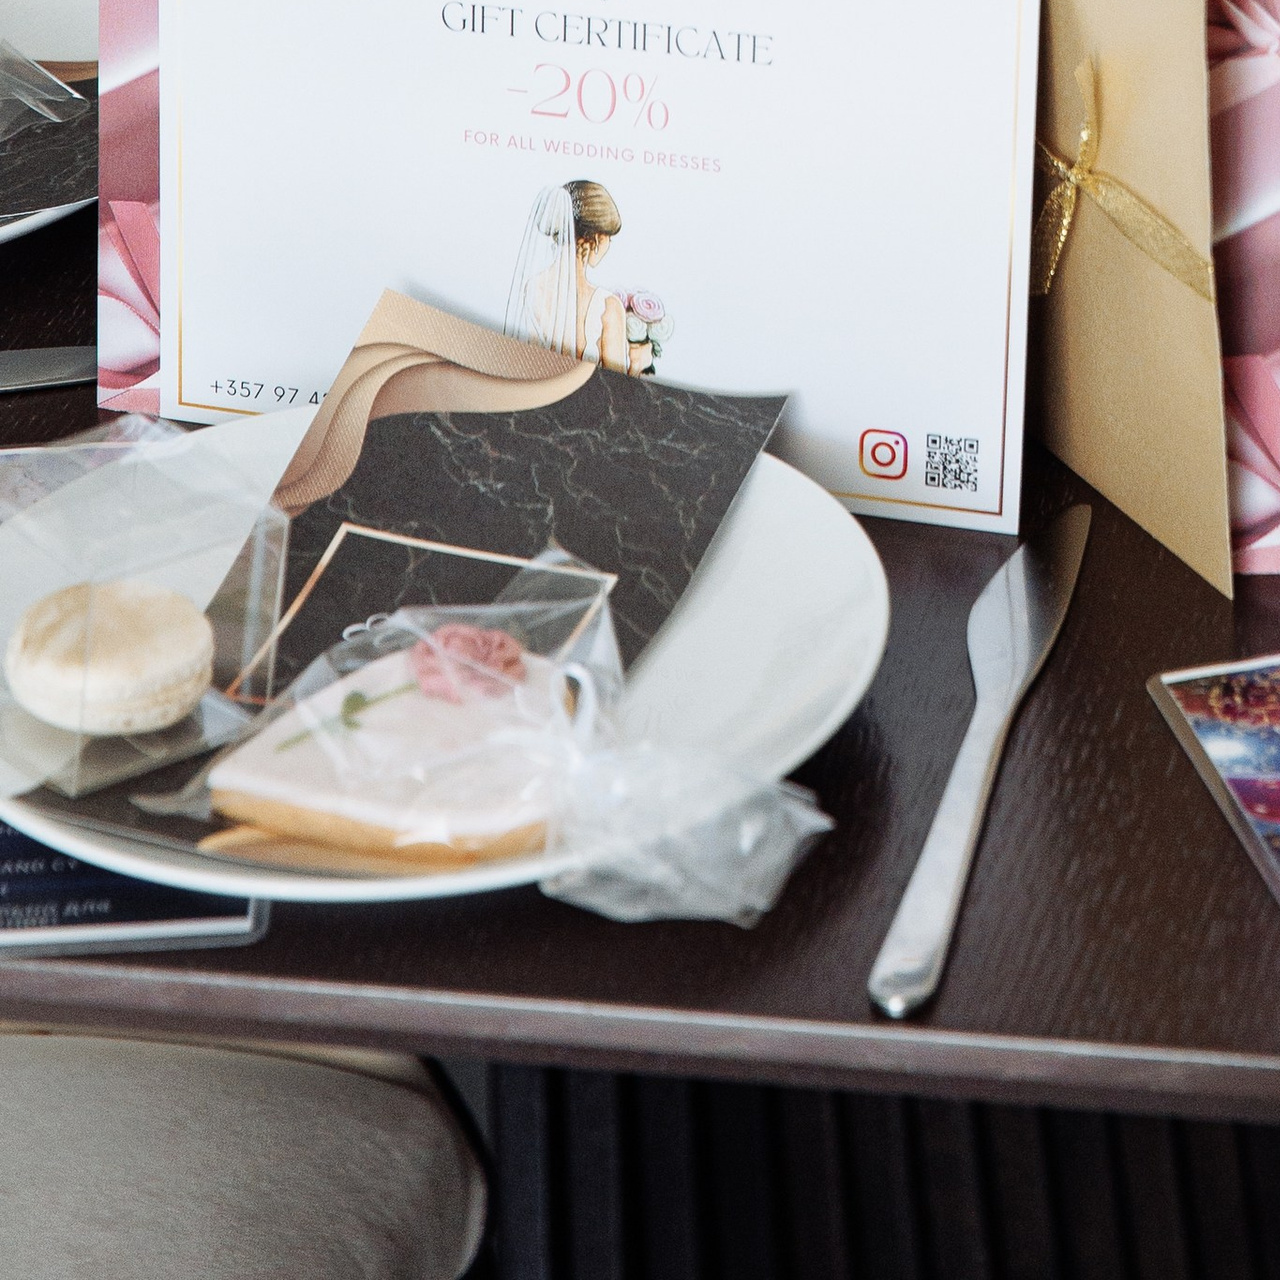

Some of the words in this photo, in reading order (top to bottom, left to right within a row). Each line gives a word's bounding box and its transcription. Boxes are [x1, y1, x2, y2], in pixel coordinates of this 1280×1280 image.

[441, 0, 523, 38] GIFT
[535, 11, 774, 67] CERTIFICATE
[506, 62, 670, 131] -20%
[463, 129, 500, 147] FOR
[507, 135, 537, 151] ALL
[543, 138, 635, 163] WEDDING
[643, 150, 722, 173] DRESSES
[210, 379, 265, 400] +357
[273, 385, 299, 405] 97
[308, 390, 328, 405] 4
